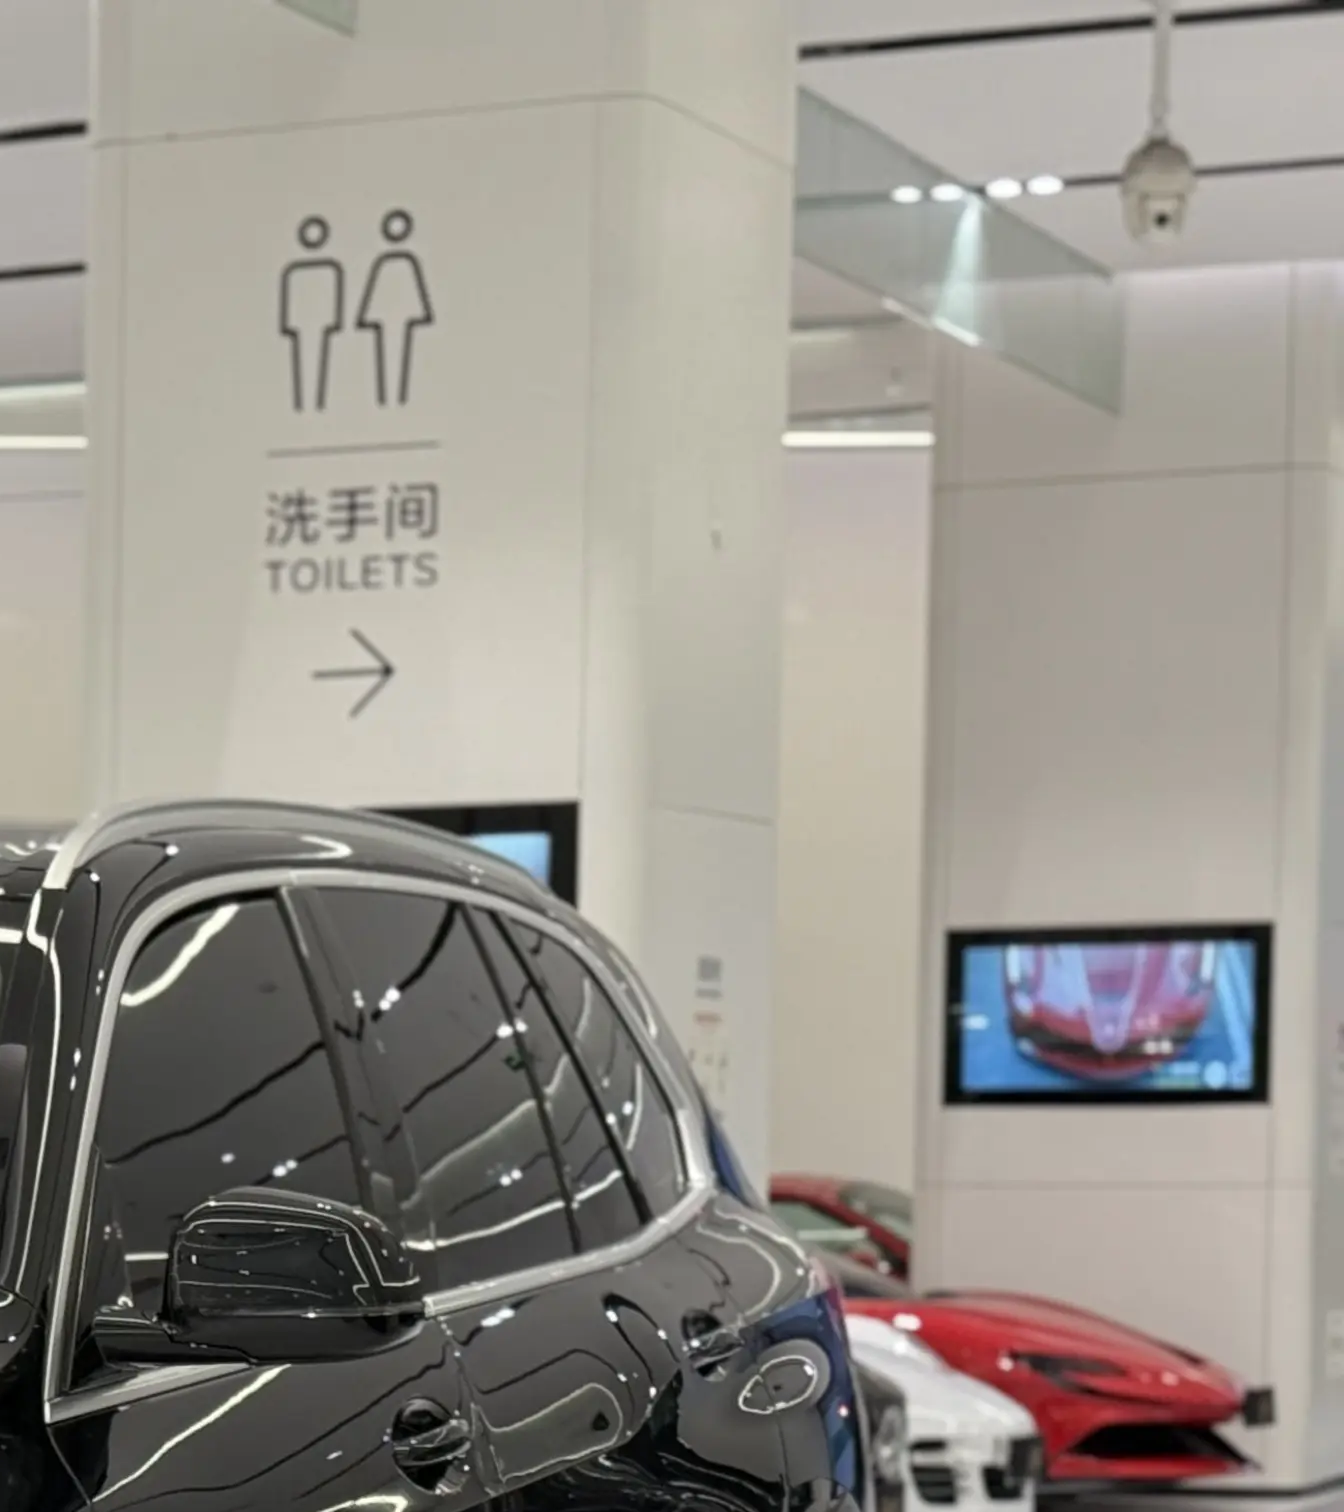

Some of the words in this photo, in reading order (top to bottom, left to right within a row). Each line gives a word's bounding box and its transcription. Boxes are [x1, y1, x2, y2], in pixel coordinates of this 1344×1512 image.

[264, 481, 439, 546] 洗手间
[263, 550, 440, 594] TOILETS
